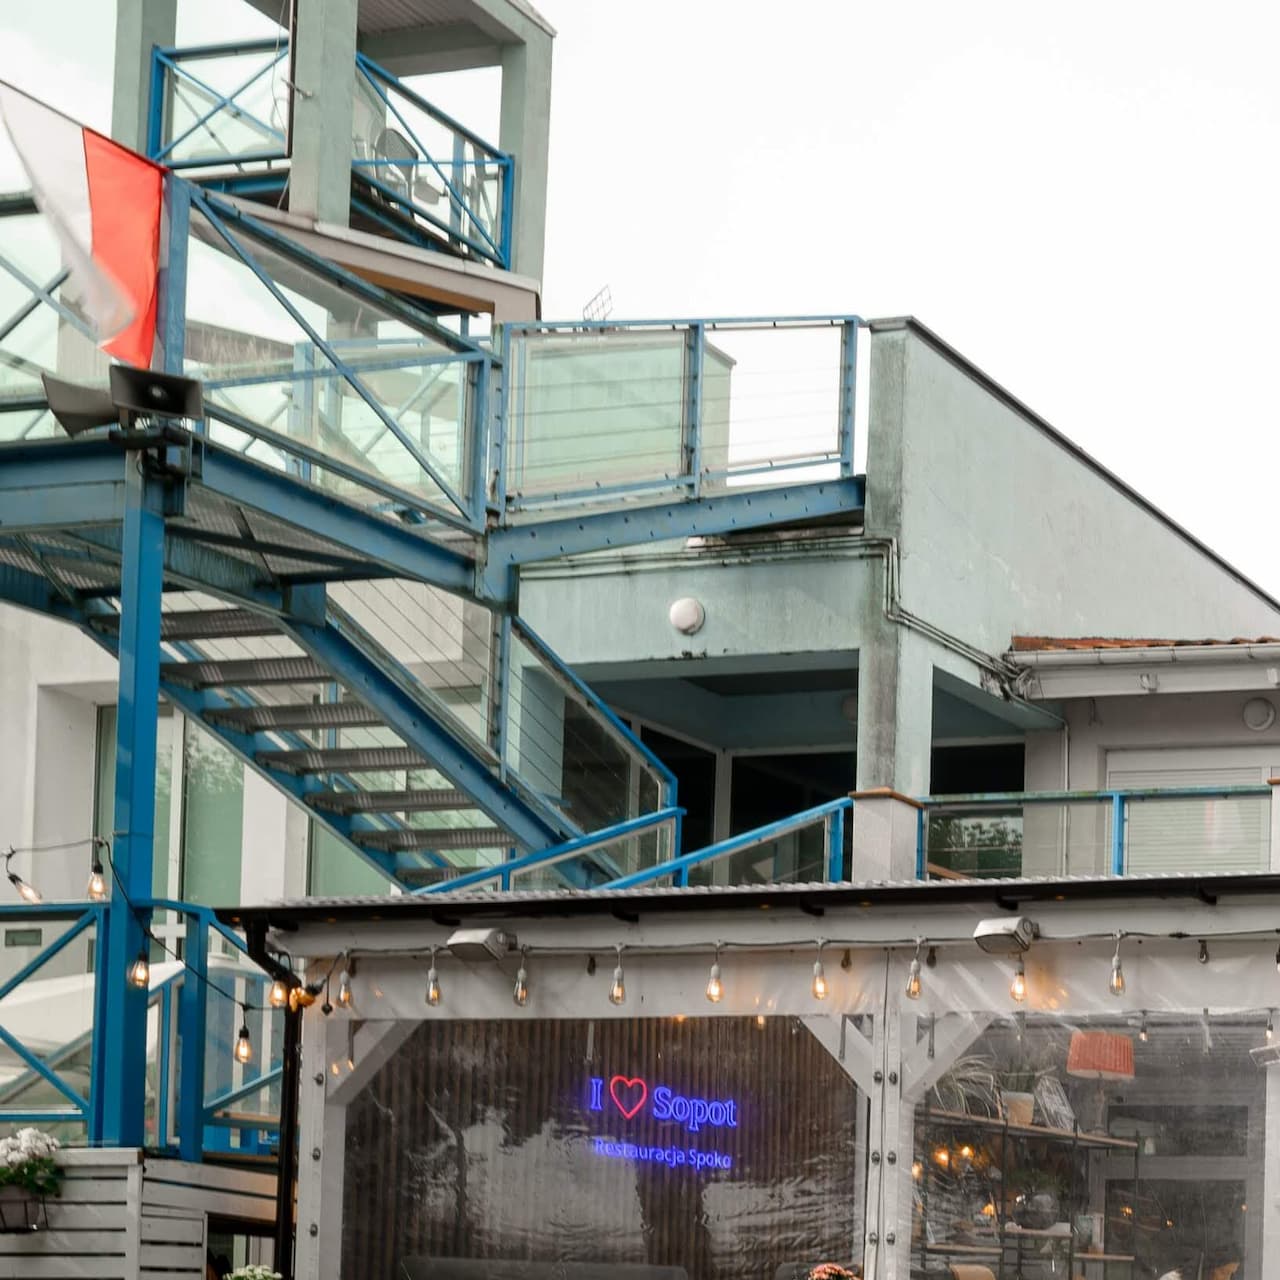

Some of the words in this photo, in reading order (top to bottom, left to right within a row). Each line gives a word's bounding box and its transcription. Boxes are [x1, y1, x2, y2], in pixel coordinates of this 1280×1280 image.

[590, 1078, 603, 1111] I
[653, 1086, 737, 1131] Sopot
[594, 1138, 686, 1168] Restauracja
[689, 1149, 732, 1171] Spoko
